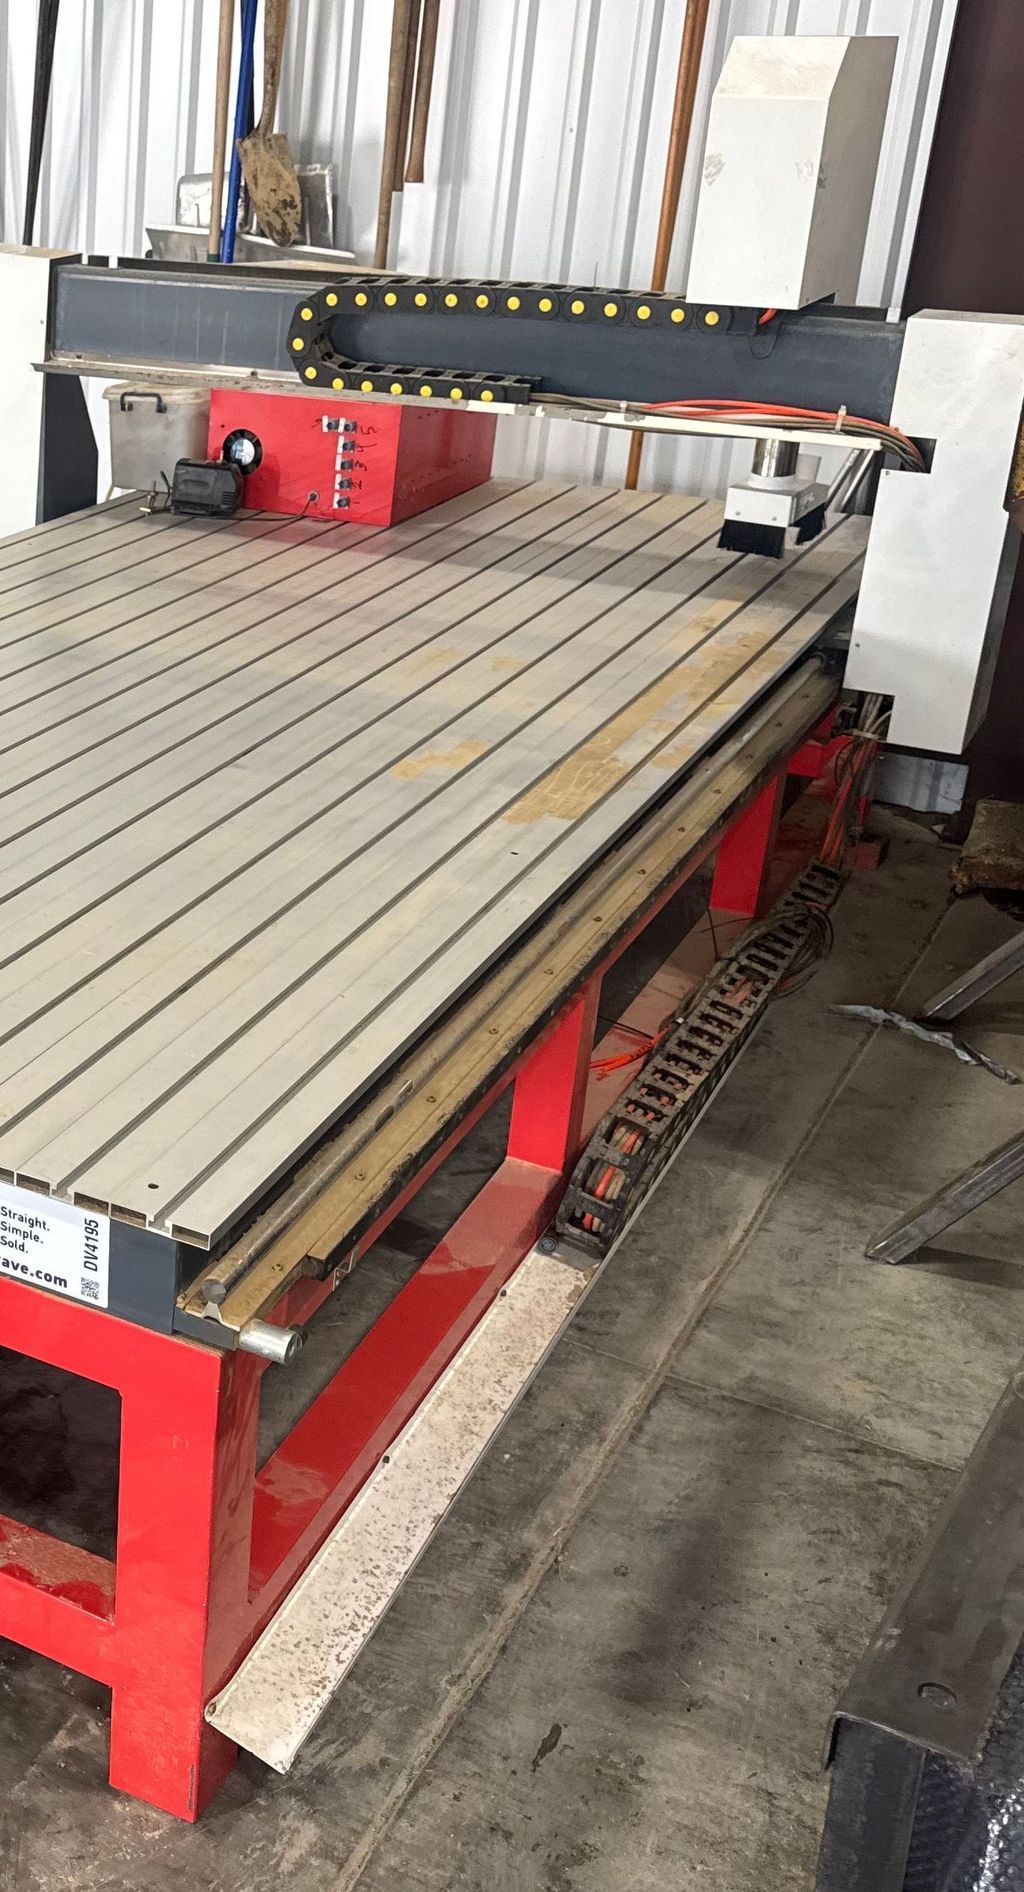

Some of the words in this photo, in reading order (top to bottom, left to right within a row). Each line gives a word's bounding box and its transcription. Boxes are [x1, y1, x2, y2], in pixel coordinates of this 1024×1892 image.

[0, 1206, 51, 1232] Straight.
[0, 1221, 44, 1245] Simple.
[0, 1235, 29, 1254] Sold.
[83, 1217, 99, 1272] DV4195
